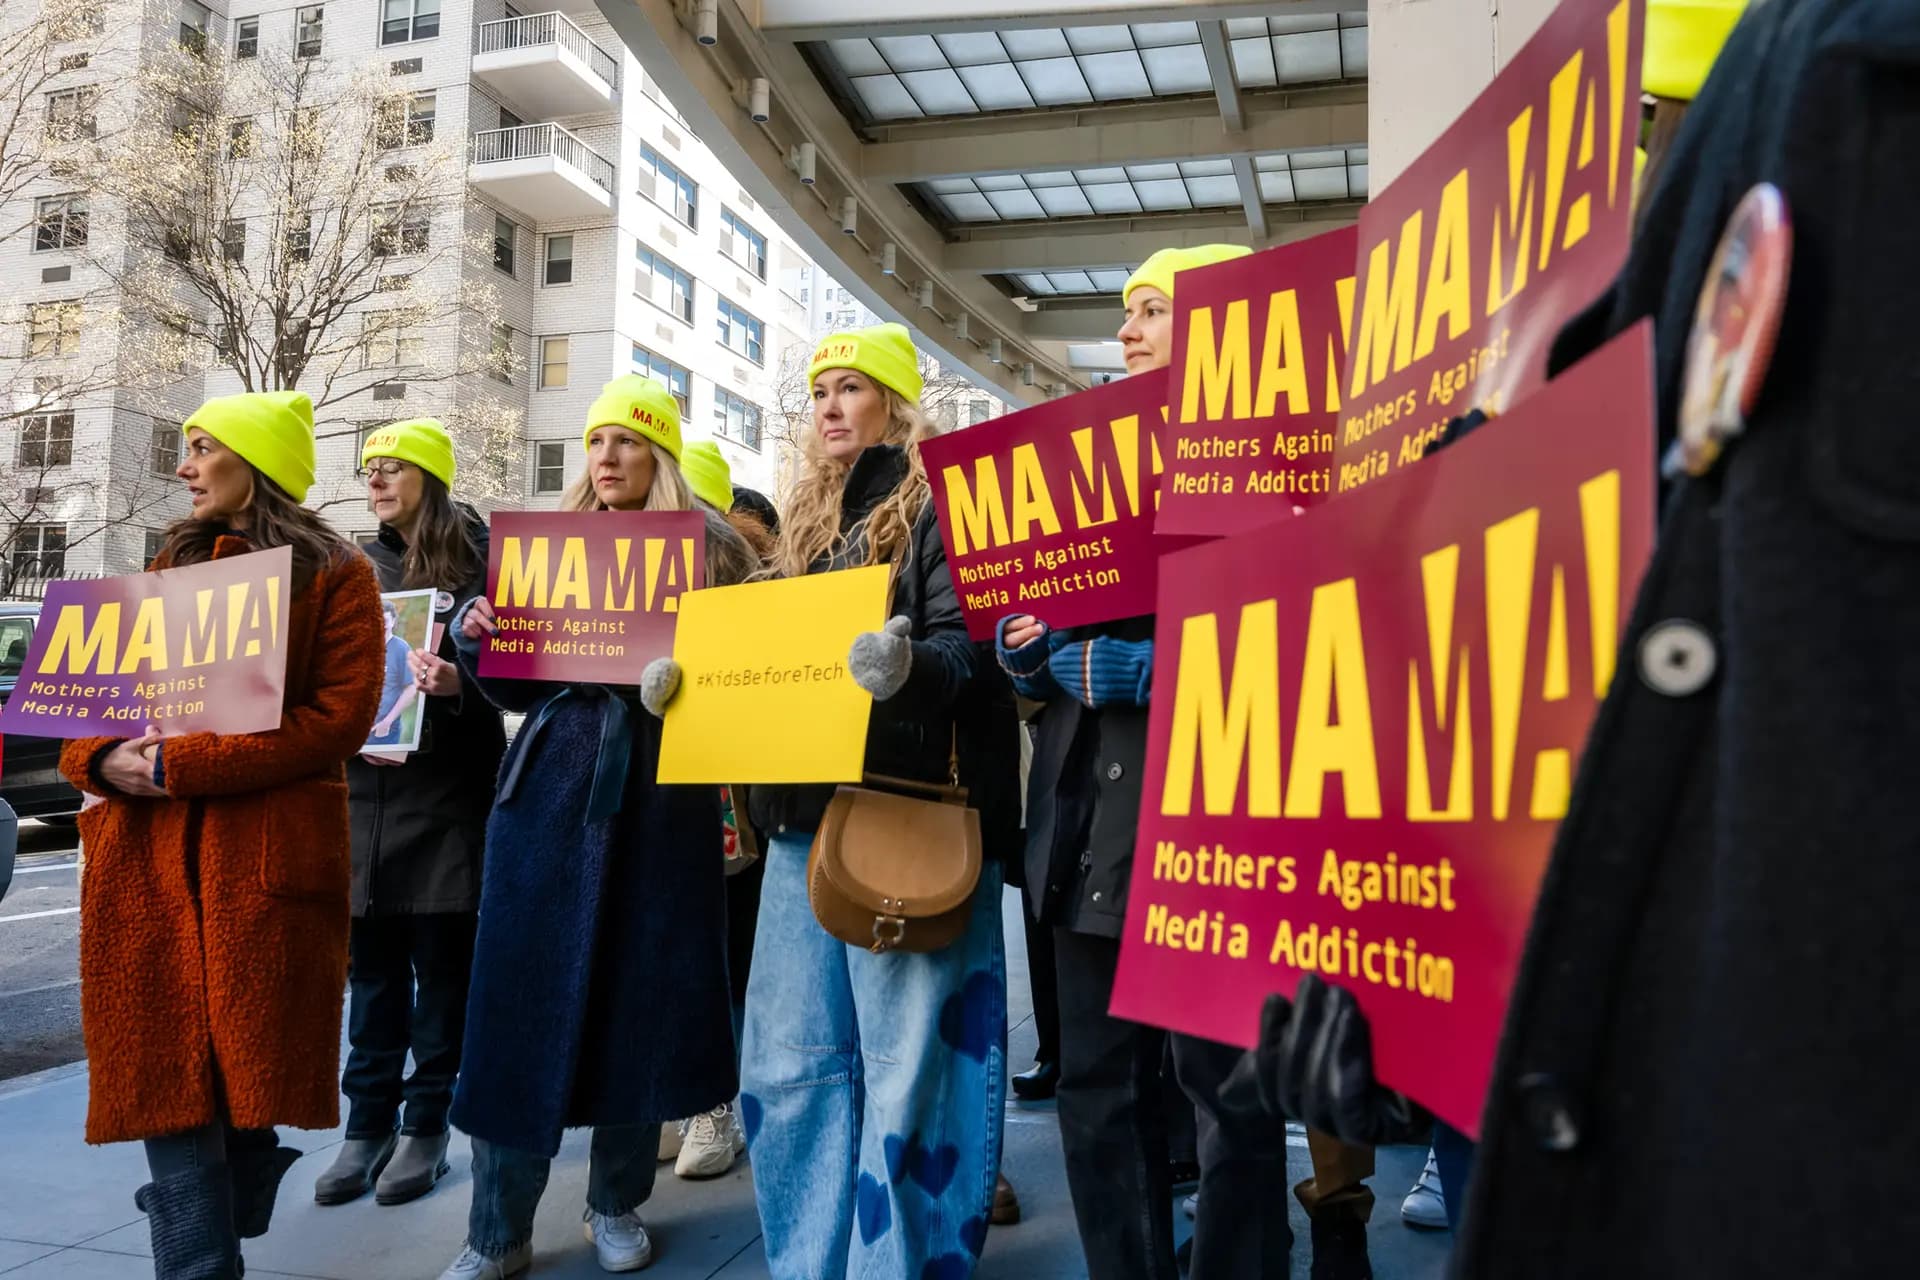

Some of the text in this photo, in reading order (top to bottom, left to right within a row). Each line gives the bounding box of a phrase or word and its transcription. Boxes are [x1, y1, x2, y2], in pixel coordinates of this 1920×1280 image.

[1344, 388, 1416, 447] Mothers
[1427, 328, 1510, 406] Against
[1177, 429, 1337, 461] Mothers Again
[1173, 468, 1331, 494] Media Addicti
[1338, 450, 1390, 493] Media
[958, 536, 1114, 585] Mothers Against
[965, 567, 1121, 611] Media Addiction
[562, 617, 625, 636] Against
[490, 637, 625, 657] Media Addiction
[29, 676, 206, 699] Mothers Against
[696, 661, 844, 688] #KidsBeforeTech
[21, 699, 204, 721] Media Addiction
[1153, 841, 1457, 911] Mothers Against
[1144, 905, 1455, 1003] Media Addiction
